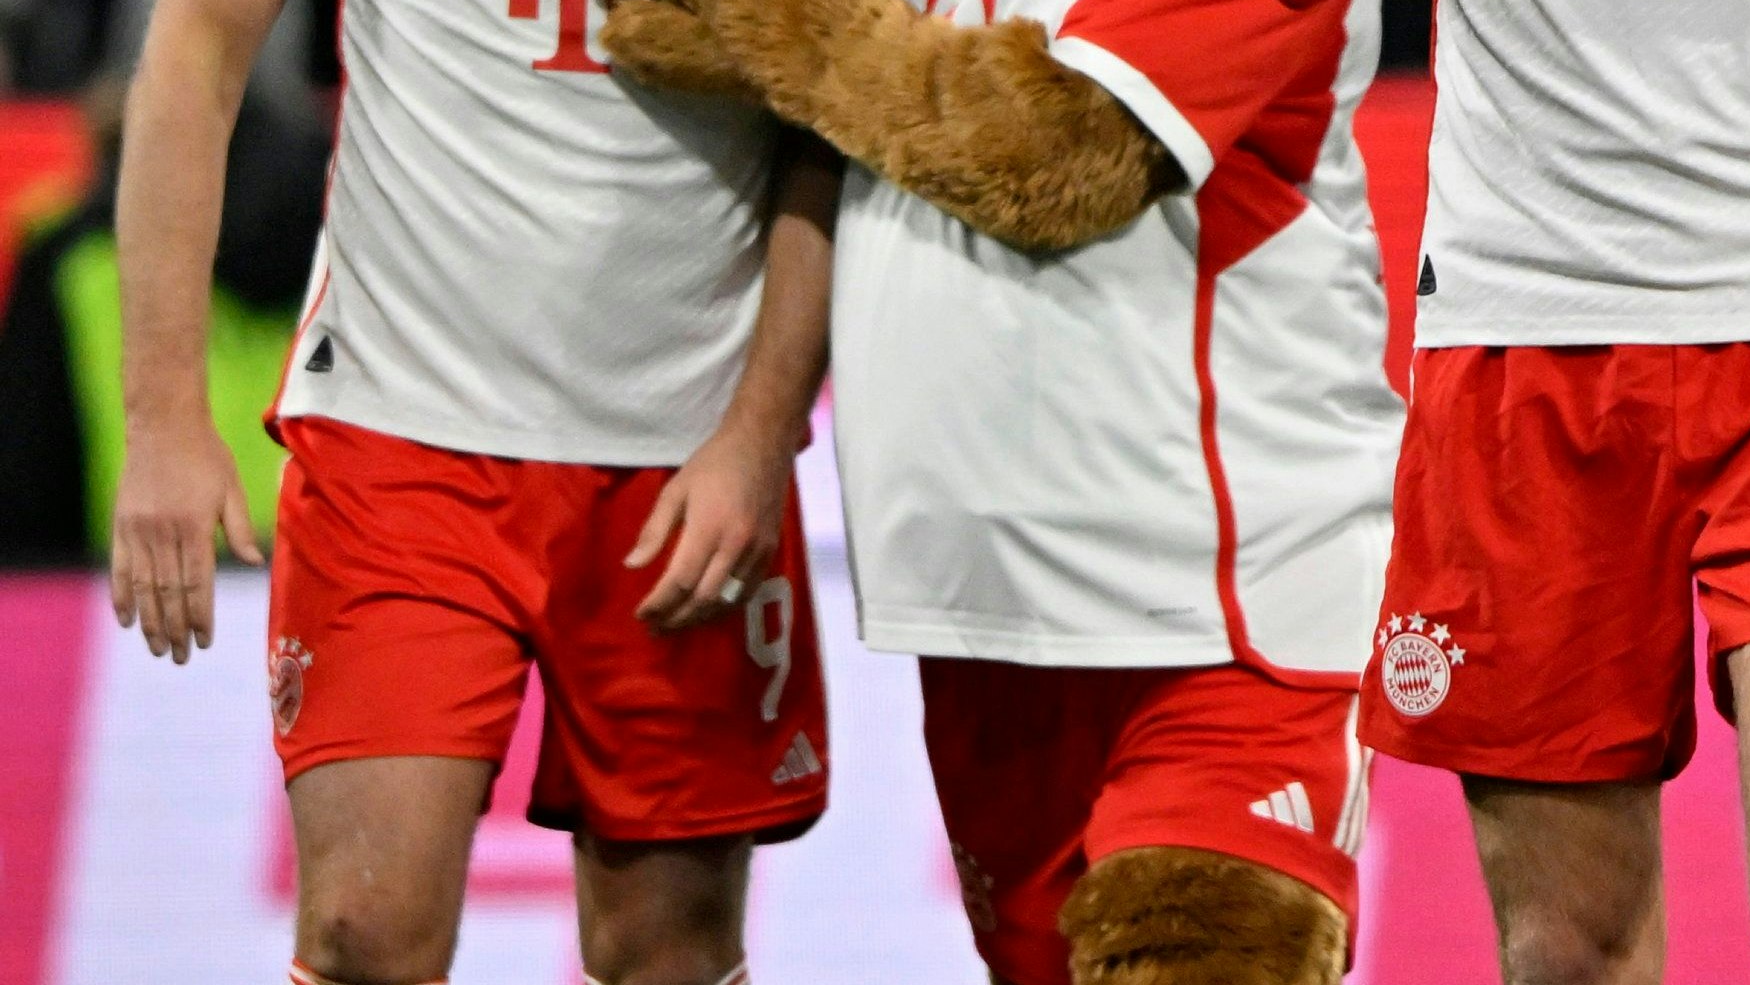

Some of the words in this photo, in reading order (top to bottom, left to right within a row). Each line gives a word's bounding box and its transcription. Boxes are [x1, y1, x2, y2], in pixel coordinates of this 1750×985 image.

[746, 576, 793, 722] 9
[1387, 646, 1399, 664] FC
[1400, 641, 1442, 673] BAYERN
